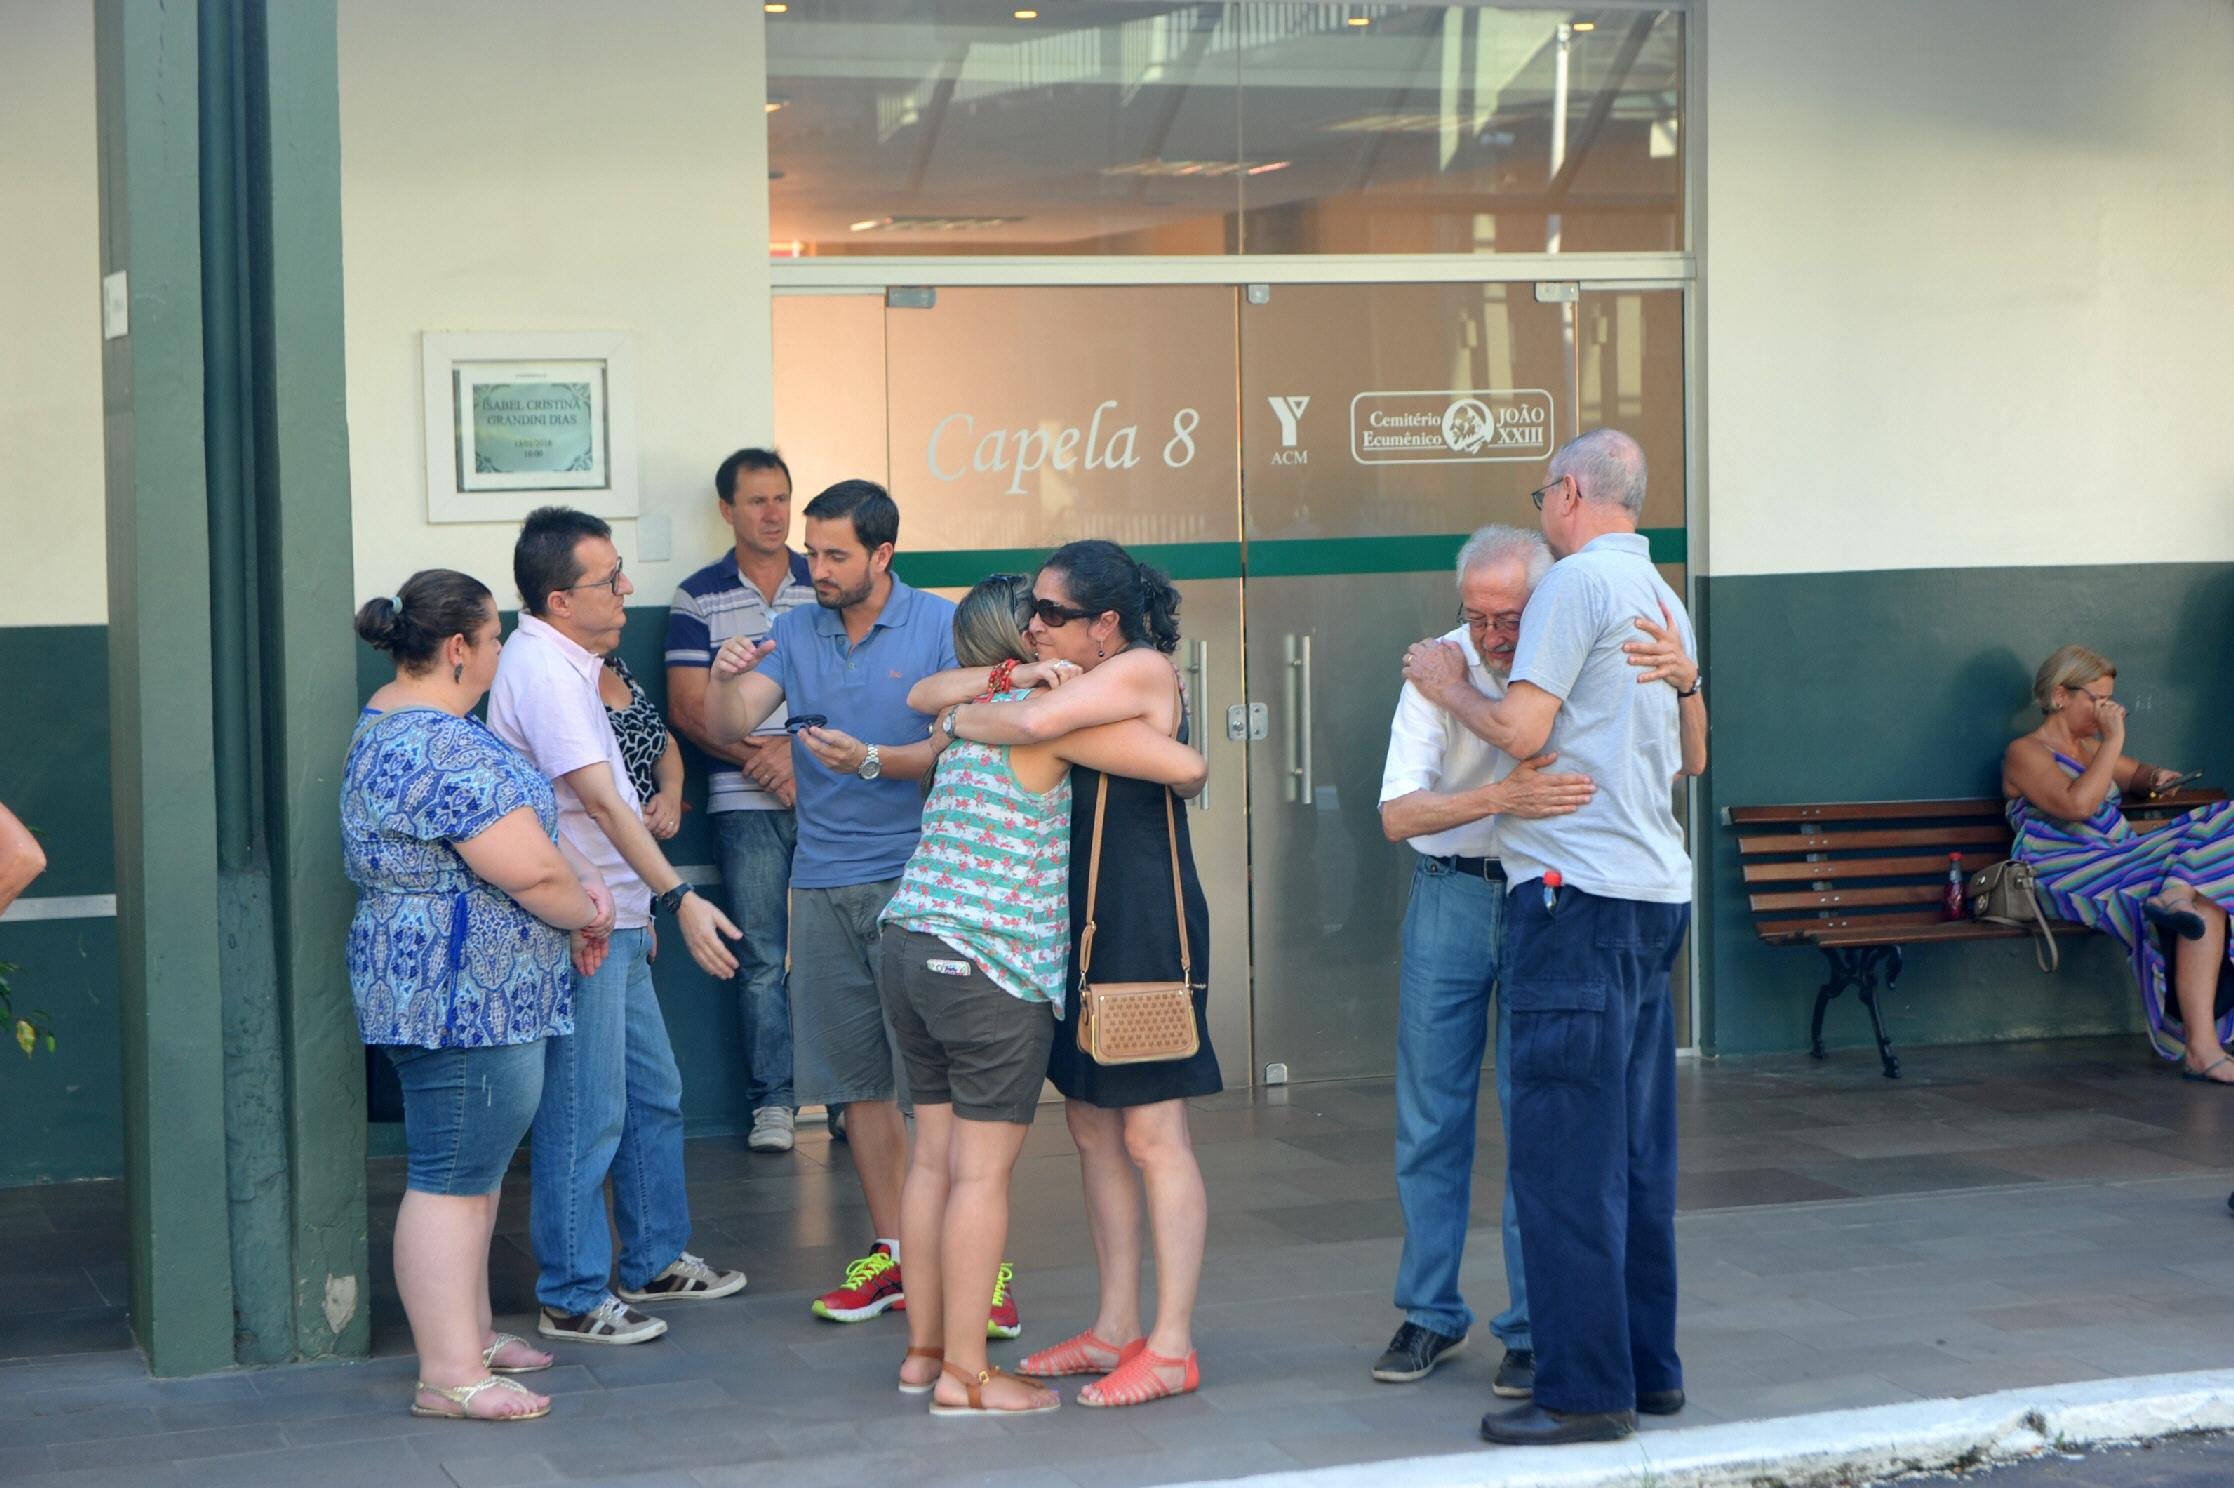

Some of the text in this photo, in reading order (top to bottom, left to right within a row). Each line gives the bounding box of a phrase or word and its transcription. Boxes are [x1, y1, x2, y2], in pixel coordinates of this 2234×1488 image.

[482, 399, 581, 411] ISABEL CRISTINA
[487, 414, 577, 425] GRANDINI DIAS
[1370, 410, 1441, 428] Cemitério
[1496, 404, 1544, 426] JOÃO
[1363, 430, 1442, 447] Ecumênico
[1497, 427, 1544, 444] XXIII
[927, 400, 1200, 495] Capela 8
[1271, 451, 1308, 465] ACM
